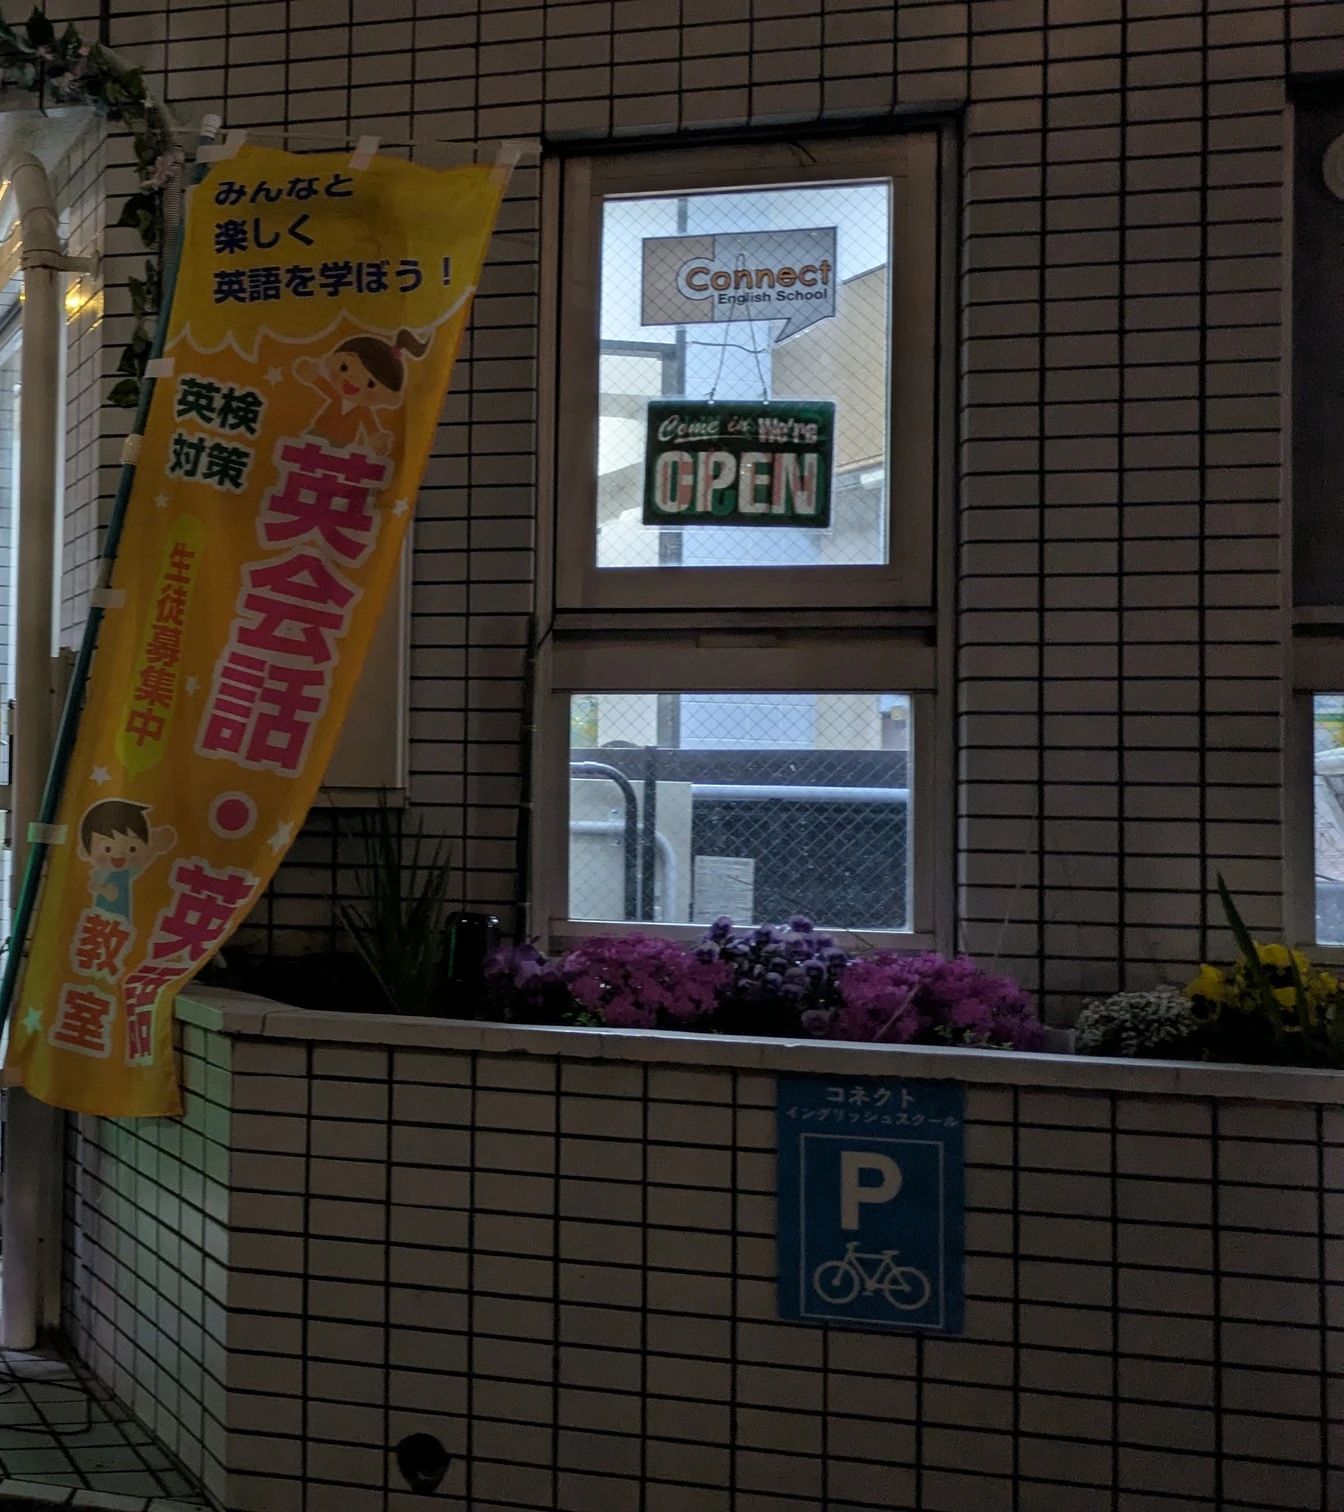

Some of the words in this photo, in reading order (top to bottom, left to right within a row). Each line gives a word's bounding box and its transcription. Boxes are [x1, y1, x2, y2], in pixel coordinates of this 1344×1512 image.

[213, 172, 354, 206] みんなと
[213, 213, 315, 254] 楽しく
[212, 256, 452, 304] 英語を学ぼう！
[685, 259, 832, 292] Connect
[718, 291, 771, 305] English
[775, 288, 828, 302] School
[175, 377, 264, 435] 英検
[657, 414, 720, 443] Come
[758, 418, 818, 443] We're
[168, 432, 252, 490] 対策
[655, 451, 818, 515] OPEN
[200, 443, 387, 770] 英会話
[125, 542, 195, 746] 生徒募集中
[52, 913, 130, 1052] 教室
[786, 1106, 959, 1128] イングリッシュスクール
[826, 1085, 915, 1108] コネクト
[840, 1151, 902, 1230] P
